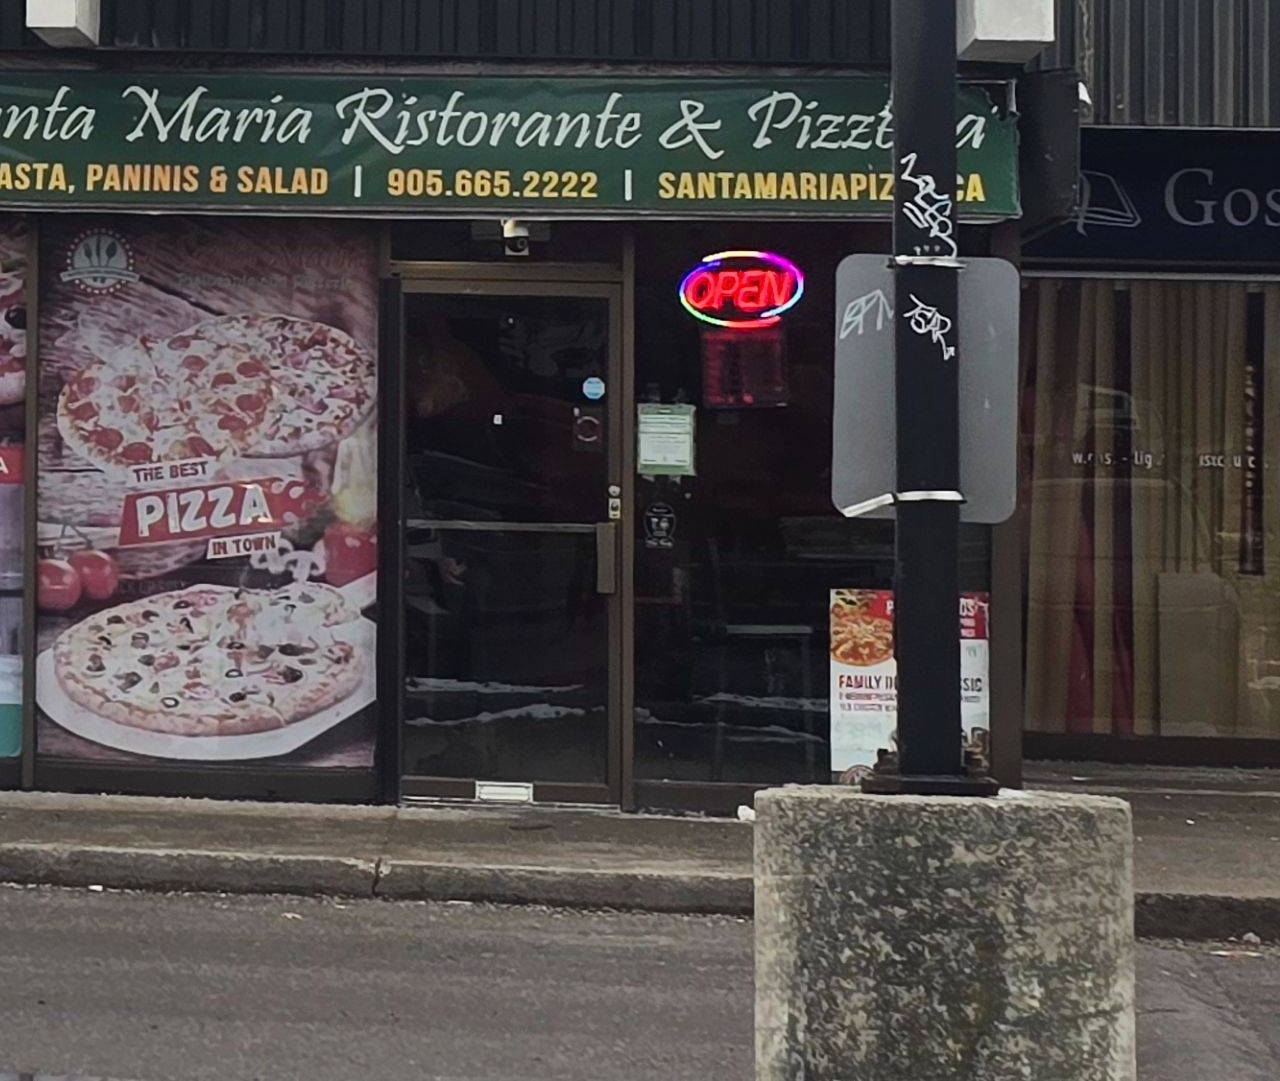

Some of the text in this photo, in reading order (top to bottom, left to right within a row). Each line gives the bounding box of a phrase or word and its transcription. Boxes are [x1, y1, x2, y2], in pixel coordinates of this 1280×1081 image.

[122, 85, 313, 143] Maria
[335, 87, 642, 154] Ristorante
[659, 100, 724, 159] &
[86, 164, 199, 193] PANINIS
[210, 166, 228, 193] &
[237, 167, 328, 195] SALAD
[387, 169, 598, 198] 905.665.2222
[686, 270, 793, 311] OPEN
[133, 461, 208, 482] THE BEST
[136, 483, 273, 537] PIZZA
[212, 535, 276, 555] IN TOWN
[839, 675, 881, 690] FAMILY
